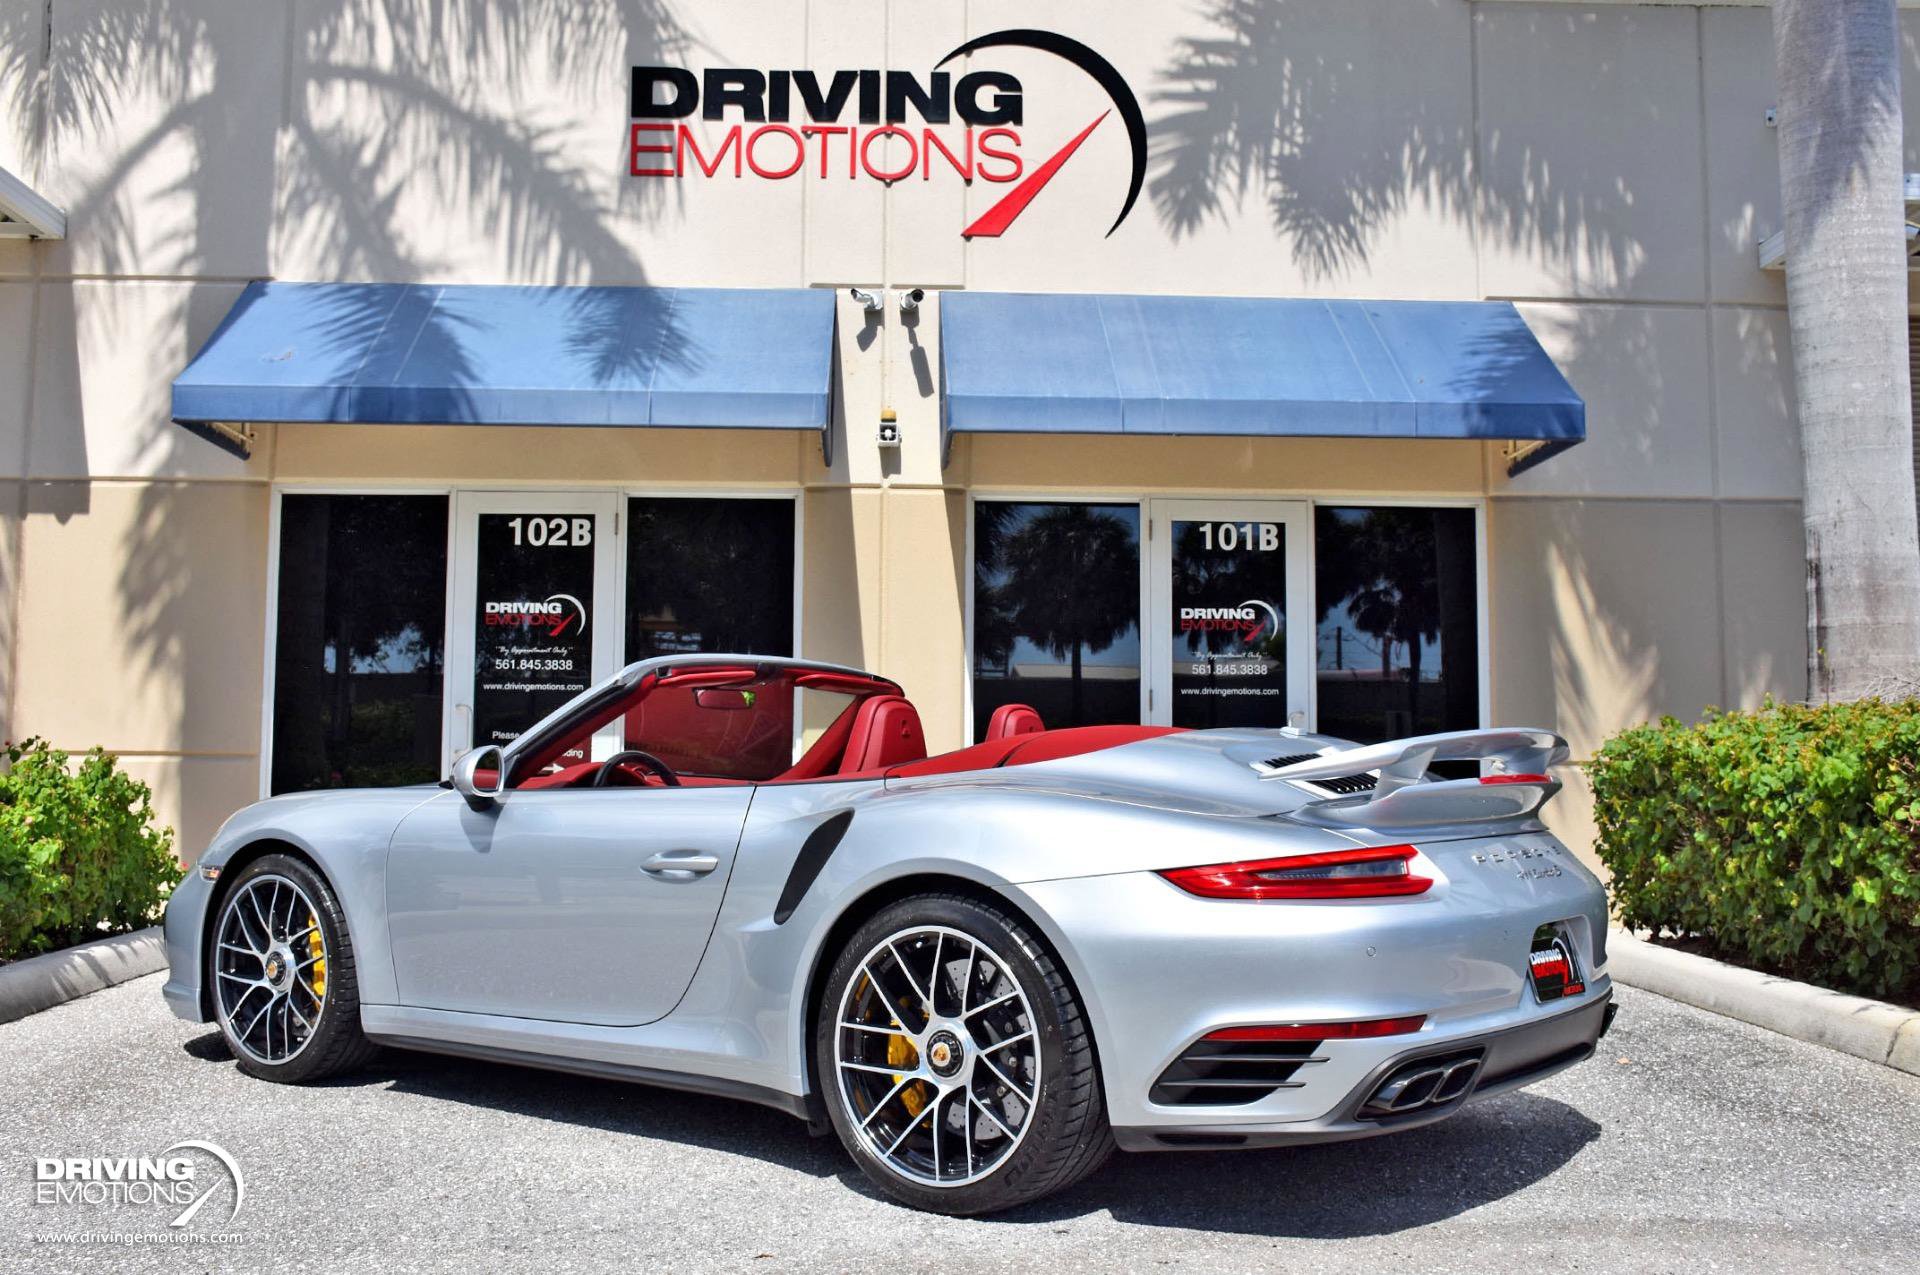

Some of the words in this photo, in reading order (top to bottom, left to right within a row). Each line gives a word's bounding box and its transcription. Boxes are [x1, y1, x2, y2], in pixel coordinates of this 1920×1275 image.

[631, 66, 1023, 126] DRIVING
[630, 124, 1024, 183] EMOTIONS
[509, 517, 592, 547] 102B
[1199, 522, 1279, 552] 101B
[485, 602, 562, 614] DRIVING
[1181, 607, 1256, 620] DRIVING
[485, 614, 562, 625] EMOTIONS
[1181, 620, 1256, 631] EMOTIONS
[495, 659, 573, 670] 561.845.3838
[1192, 664, 1268, 675] 561.845.3838
[483, 682, 584, 692] www.drivingemotions.com
[1181, 687, 1279, 697] www.drivingemotions.com
[492, 730, 520, 740] Please
[1529, 948, 1562, 965] DRIVING
